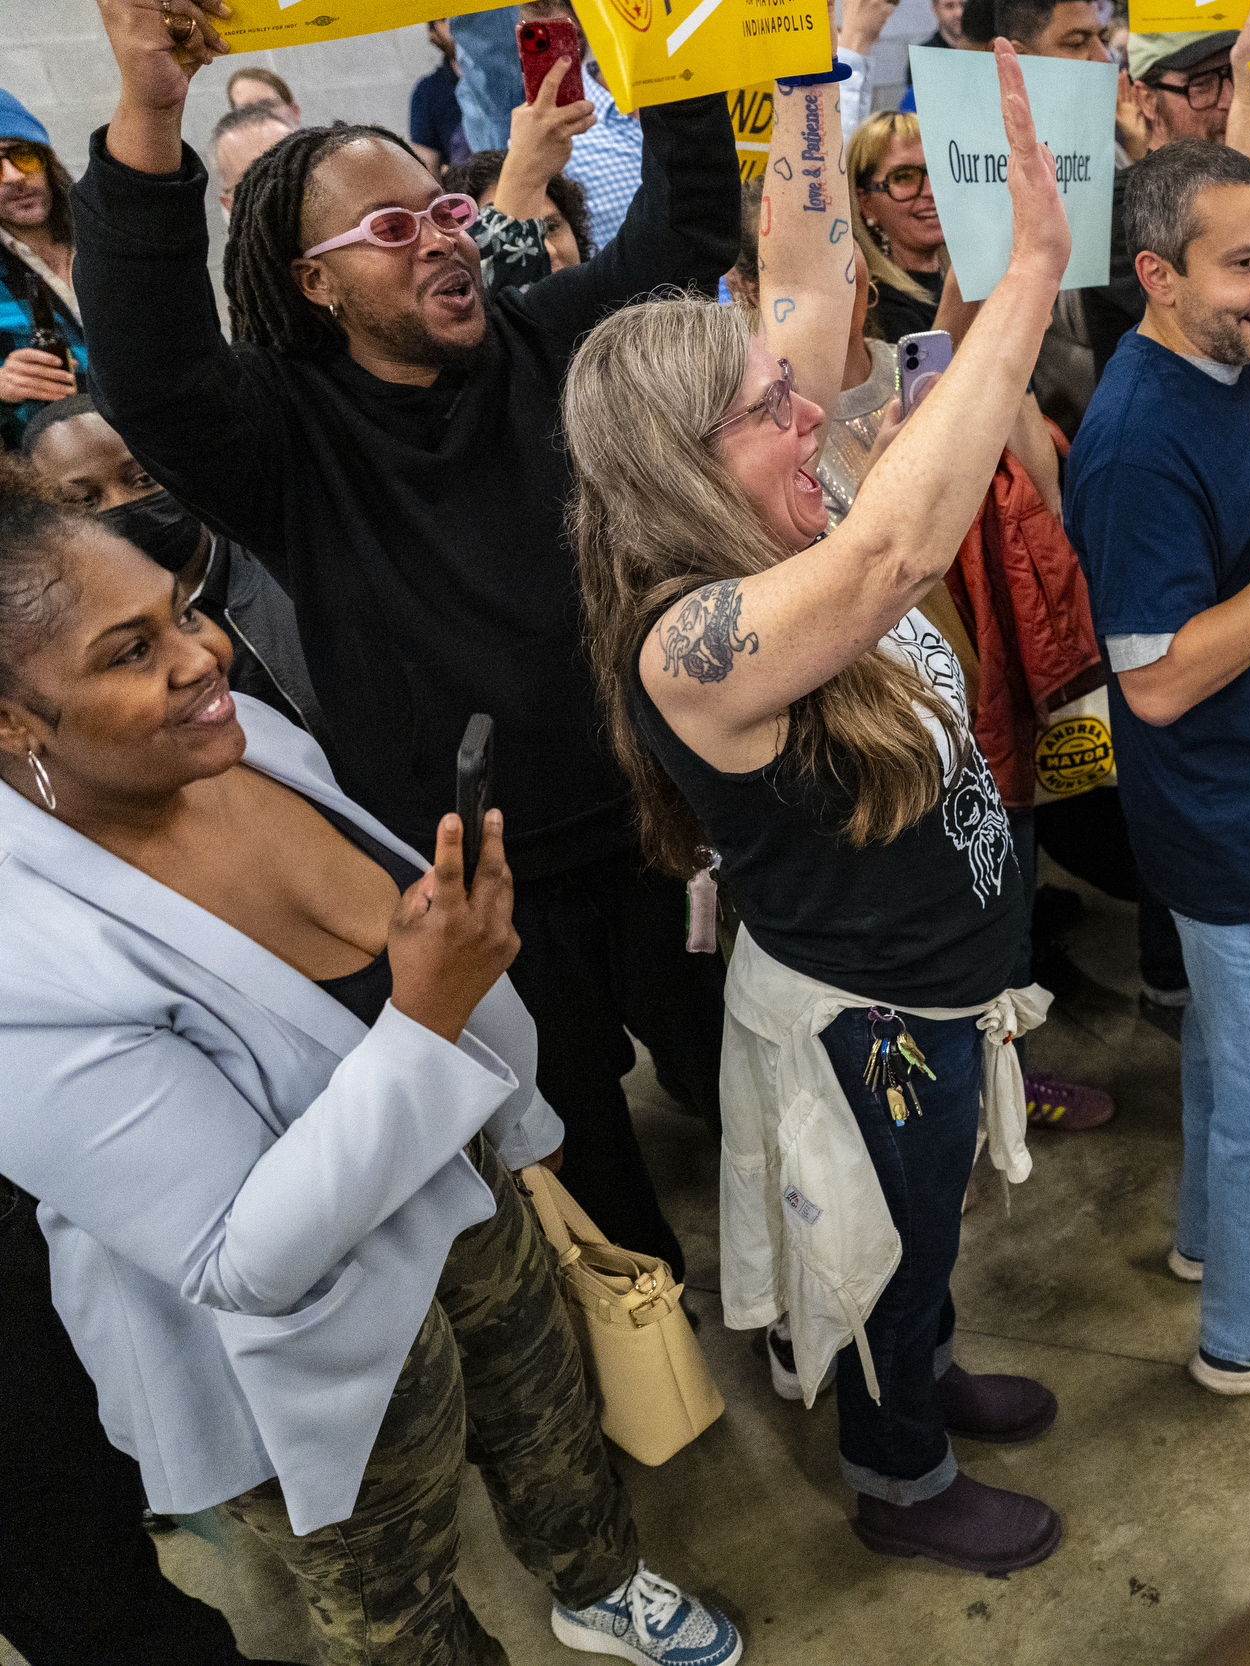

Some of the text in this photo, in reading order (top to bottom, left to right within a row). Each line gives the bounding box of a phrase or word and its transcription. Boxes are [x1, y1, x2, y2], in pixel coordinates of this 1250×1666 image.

[742, 14, 814, 37] INDIANAPOLIS
[801, 93, 827, 213] Love & Patience
[949, 140, 1091, 194] Our ne apter.
[1044, 724, 1102, 752] ANDREA
[1046, 745, 1105, 768] MAYOR
